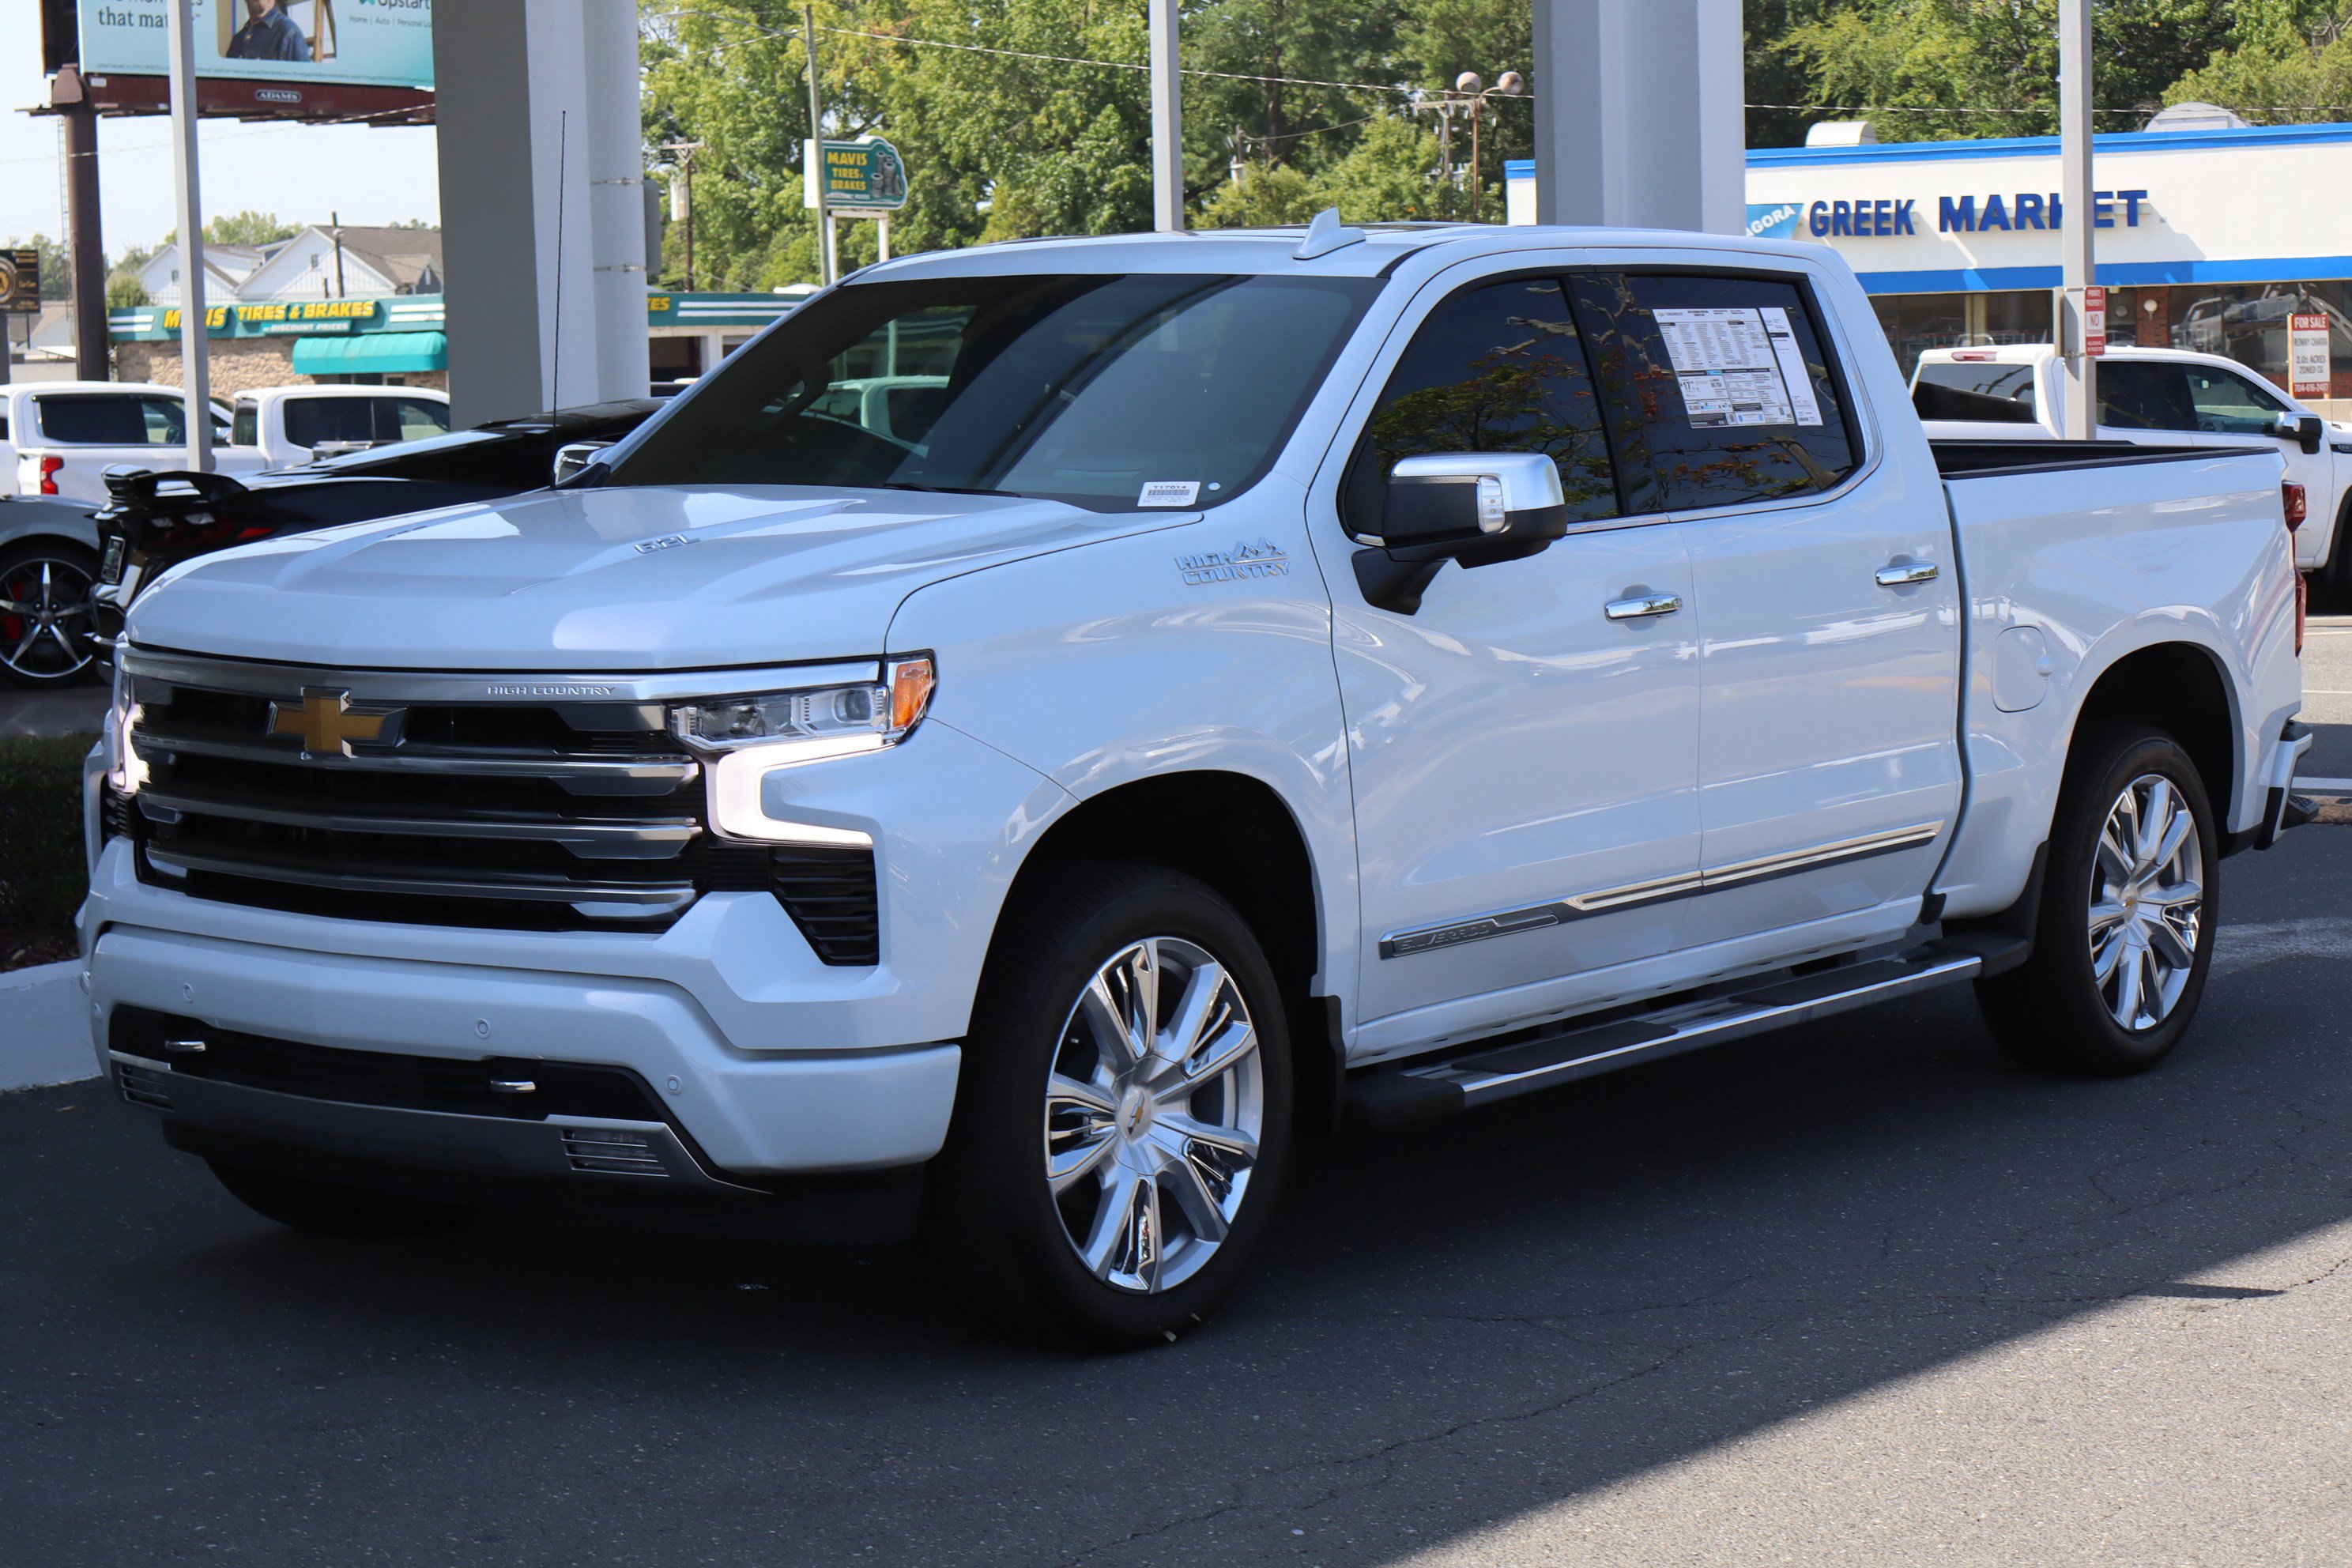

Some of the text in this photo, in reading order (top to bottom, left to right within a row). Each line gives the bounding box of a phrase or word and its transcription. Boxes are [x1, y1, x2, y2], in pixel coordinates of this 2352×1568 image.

[98, 6, 134, 27] that
[258, 91, 299, 101] ADAMS
[827, 152, 867, 165] MAVIS
[832, 168, 860, 179] TIRES
[831, 179, 866, 190] BRAKES
[1810, 199, 1916, 237] GREEK
[164, 301, 375, 328] MIS TIRES & BRAKES
[2091, 314, 2100, 326] NO
[2294, 317, 2326, 329] FOR SALE
[1174, 552, 1234, 571] HIGH
[1182, 562, 1289, 586] COUNTRY
[487, 685, 616, 696] HIGH COUNTRY
